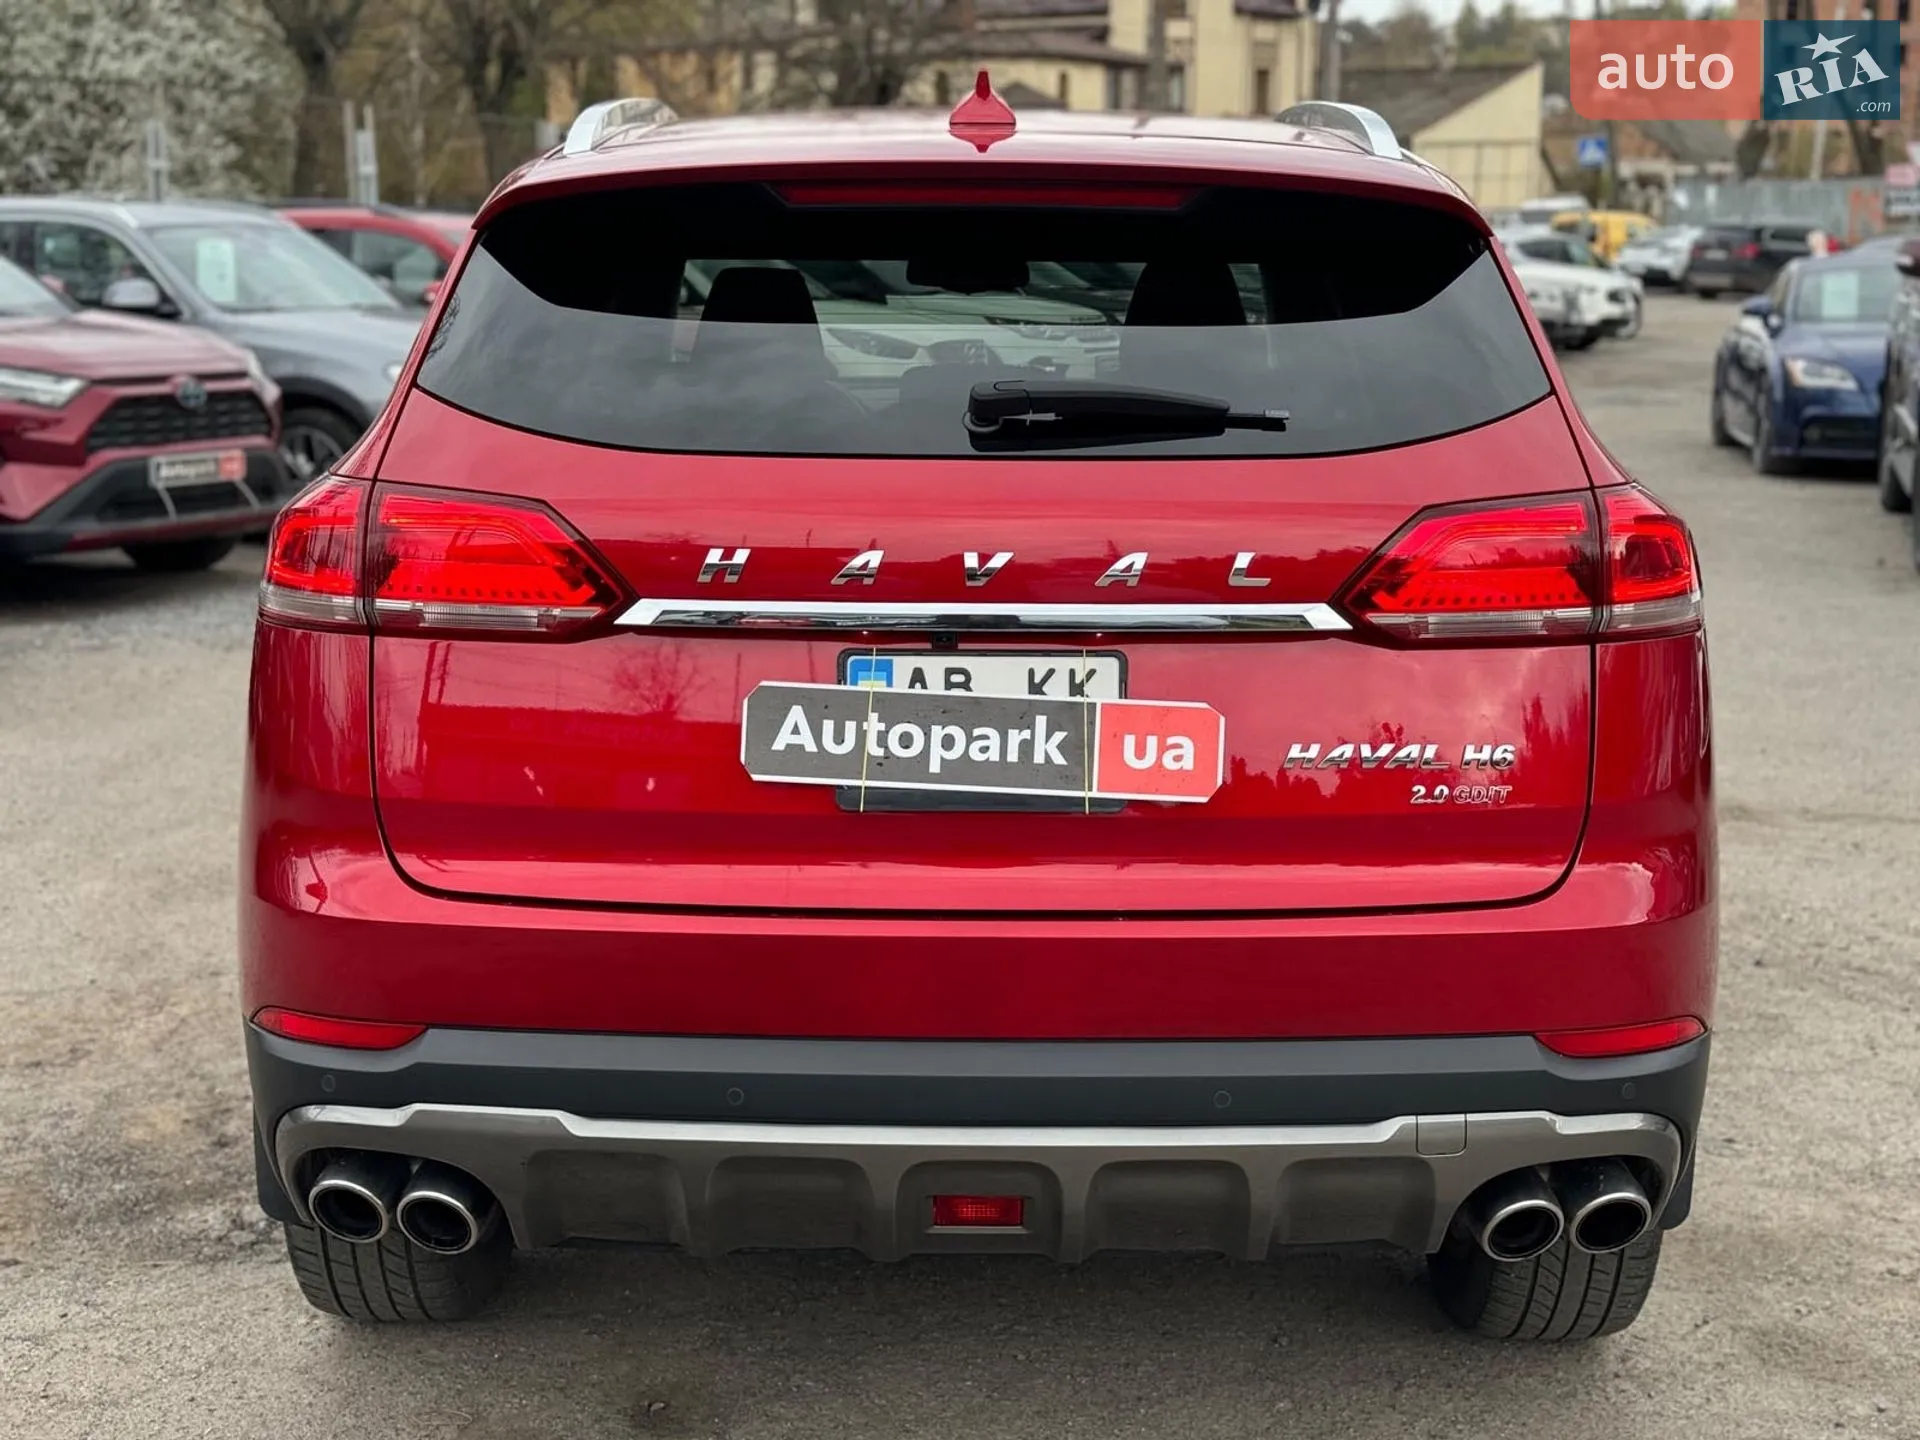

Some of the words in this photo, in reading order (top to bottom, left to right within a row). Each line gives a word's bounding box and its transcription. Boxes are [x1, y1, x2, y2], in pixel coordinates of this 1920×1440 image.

[697, 549, 1272, 587] HAVAL
[771, 705, 1068, 773] Autopark
[1122, 733, 1196, 771] ua
[1284, 743, 1450, 769] HAVAL
[1460, 744, 1516, 770] H6
